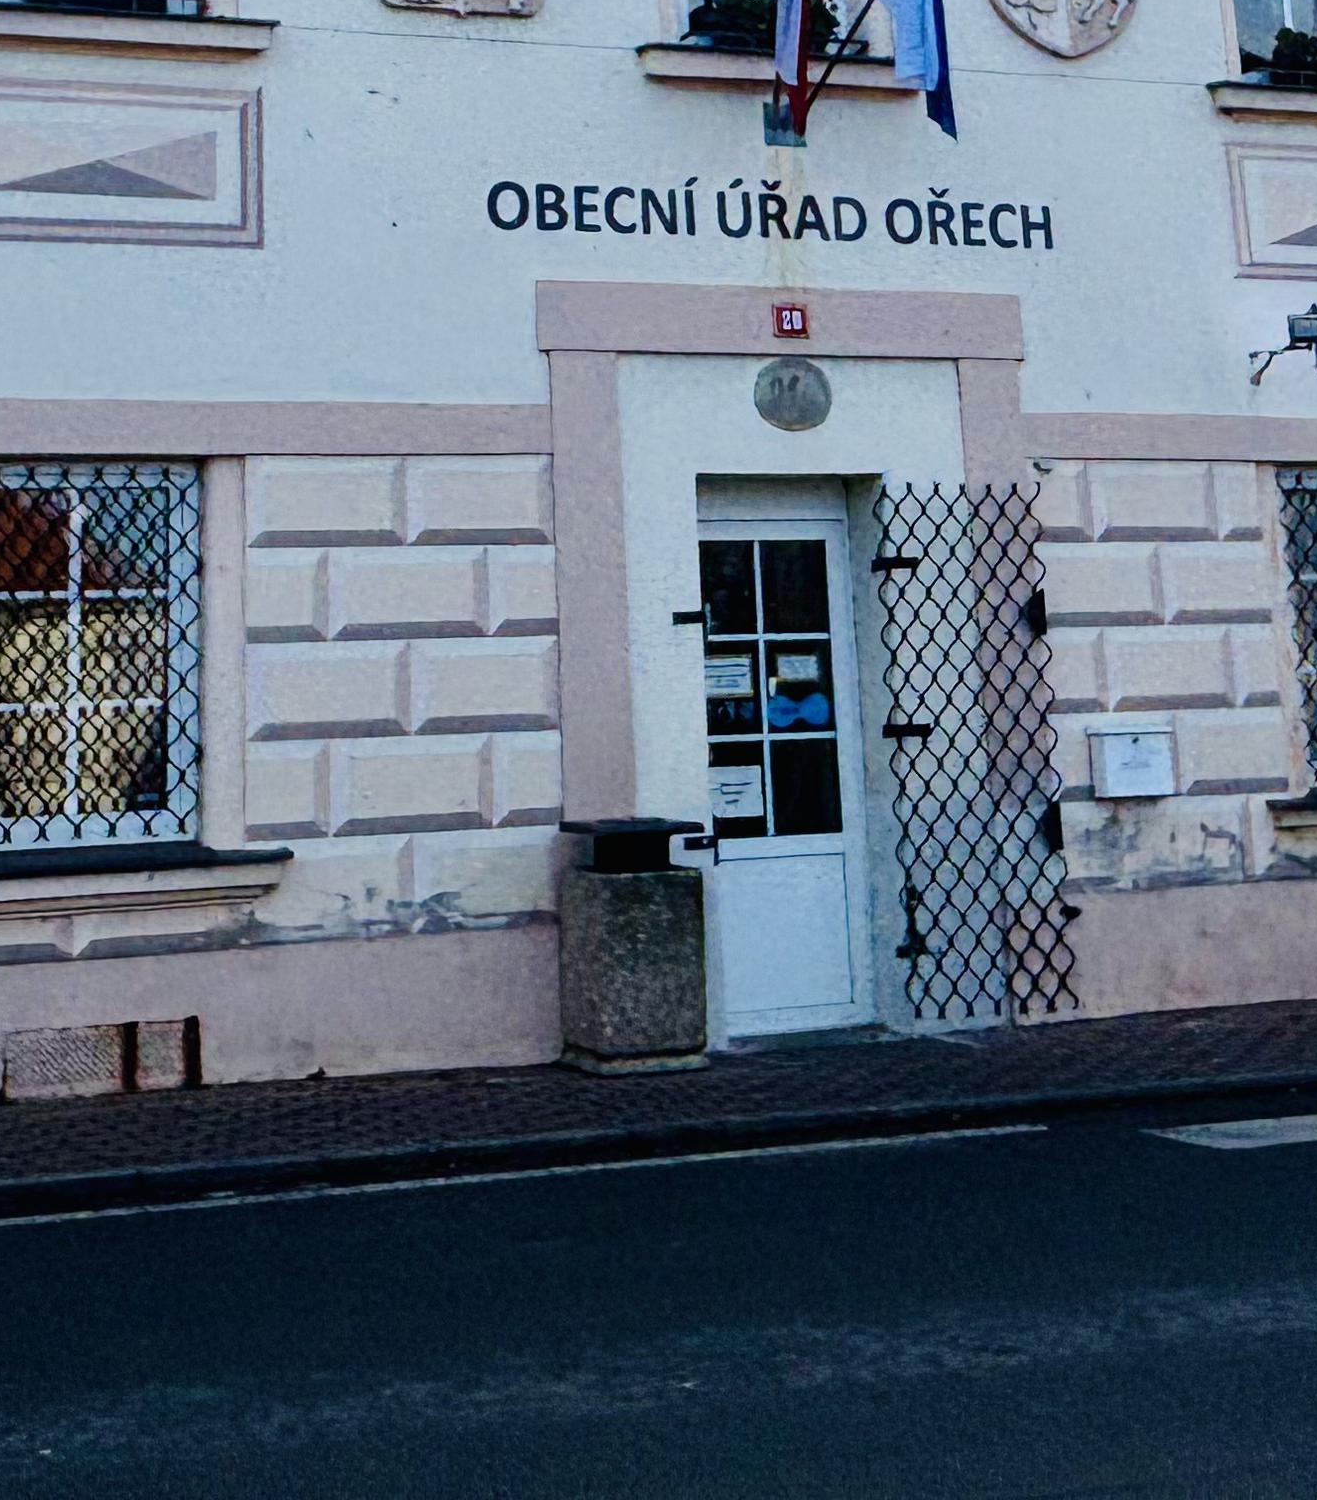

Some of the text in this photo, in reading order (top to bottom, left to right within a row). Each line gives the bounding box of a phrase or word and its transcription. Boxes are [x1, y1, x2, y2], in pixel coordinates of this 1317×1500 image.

[487, 176, 1055, 250] OBECNÍ ÚŘAD OŘECH
